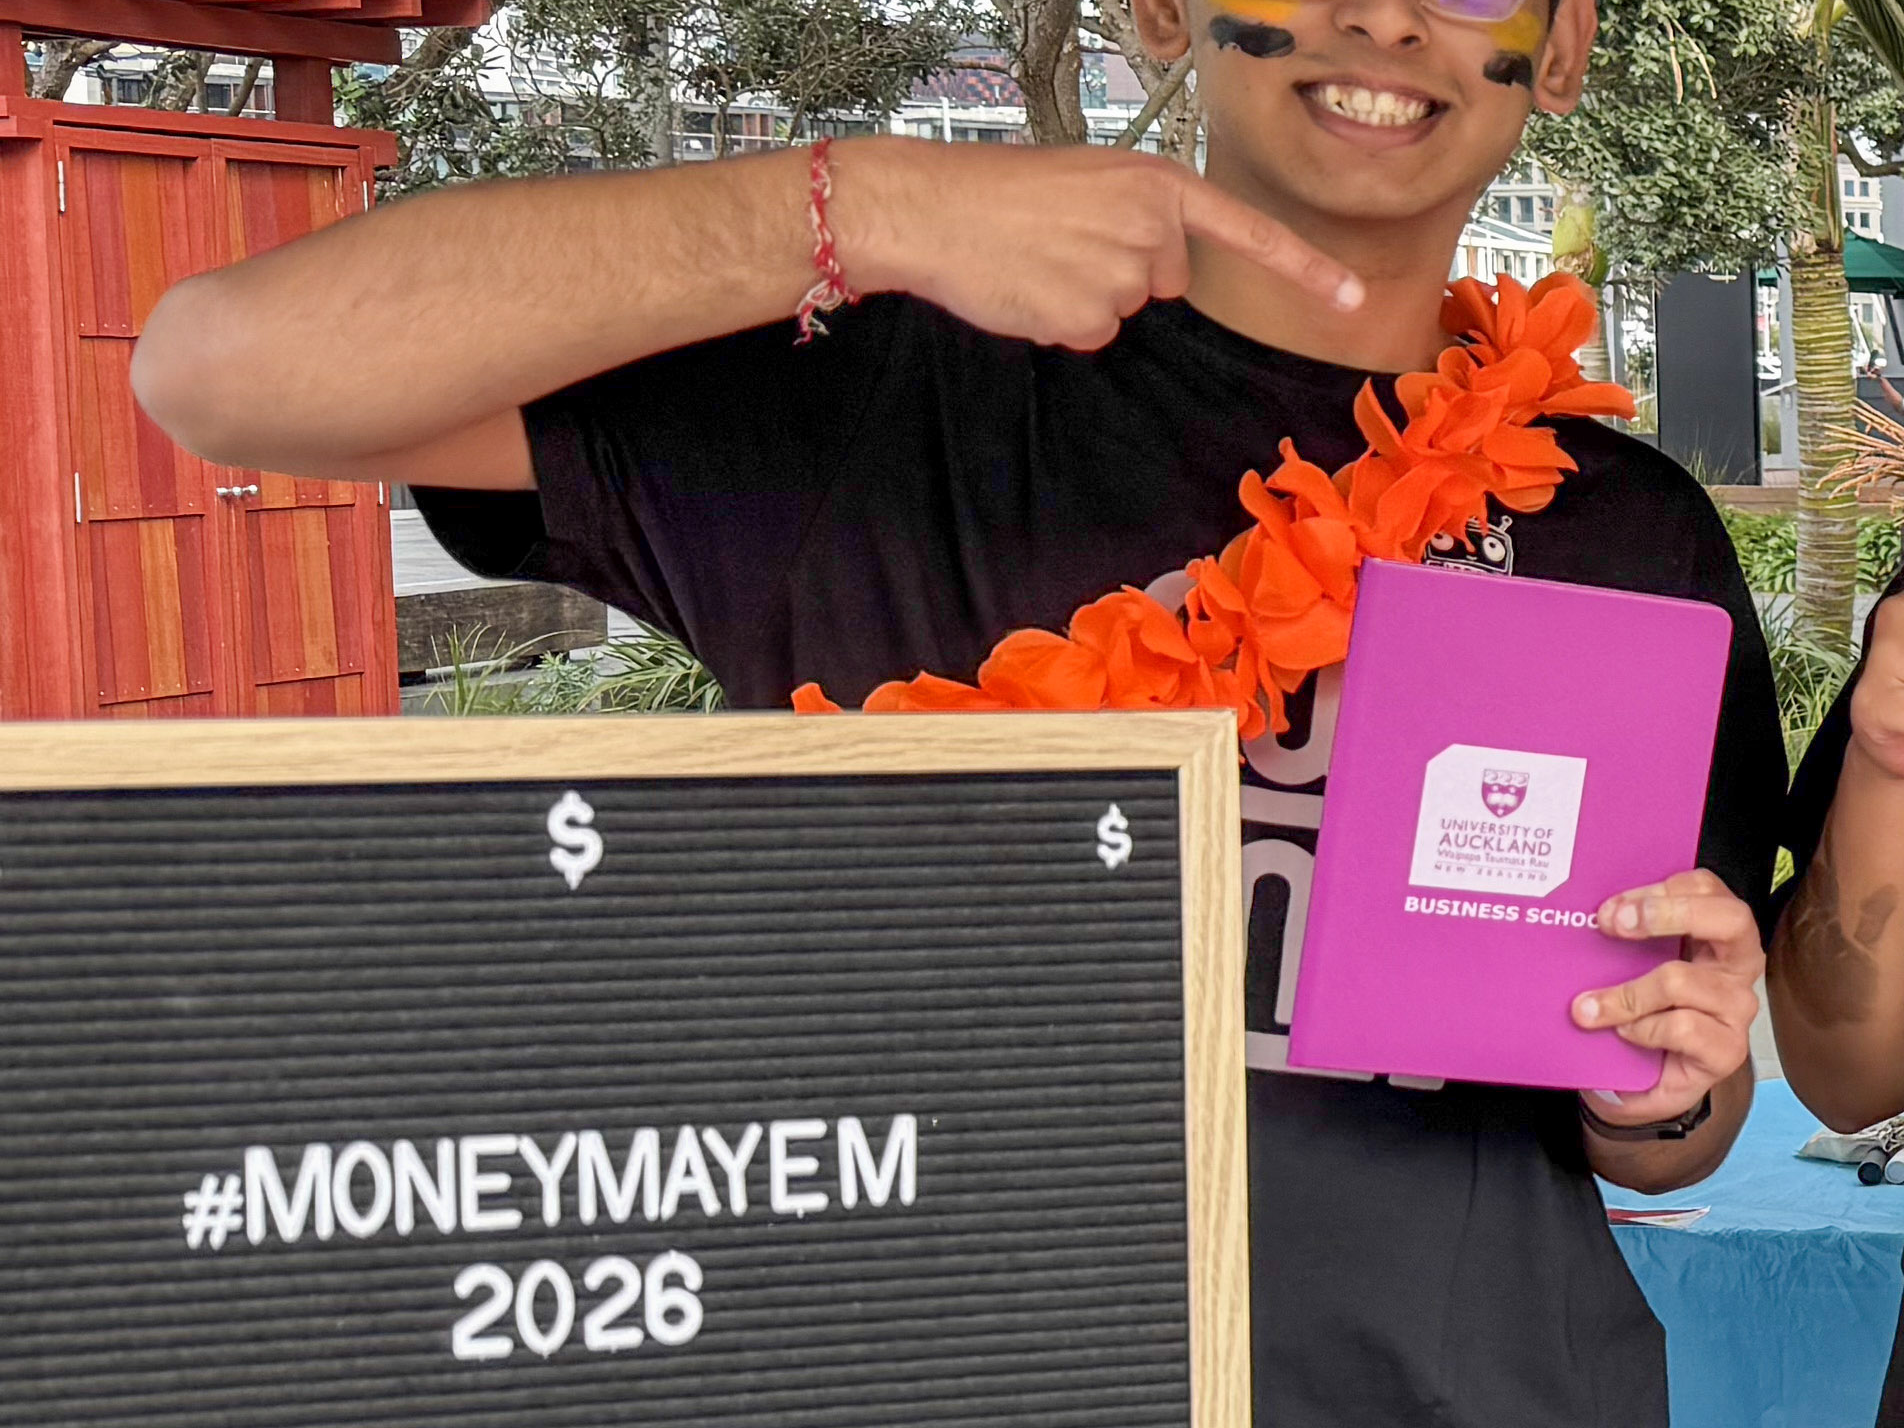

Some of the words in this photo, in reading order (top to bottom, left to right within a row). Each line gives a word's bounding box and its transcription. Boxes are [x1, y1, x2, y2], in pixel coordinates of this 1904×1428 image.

[1439, 833, 1551, 856] AUCKLAND
[1441, 818, 1531, 839] UNIVERSITY
[1535, 828, 1554, 839] OF
[1404, 896, 1520, 922] BUSINESS
[1525, 908, 1600, 929] SCHOO
[184, 1115, 919, 1249] #MONEYMAYEM
[452, 1252, 703, 1359] 2026
